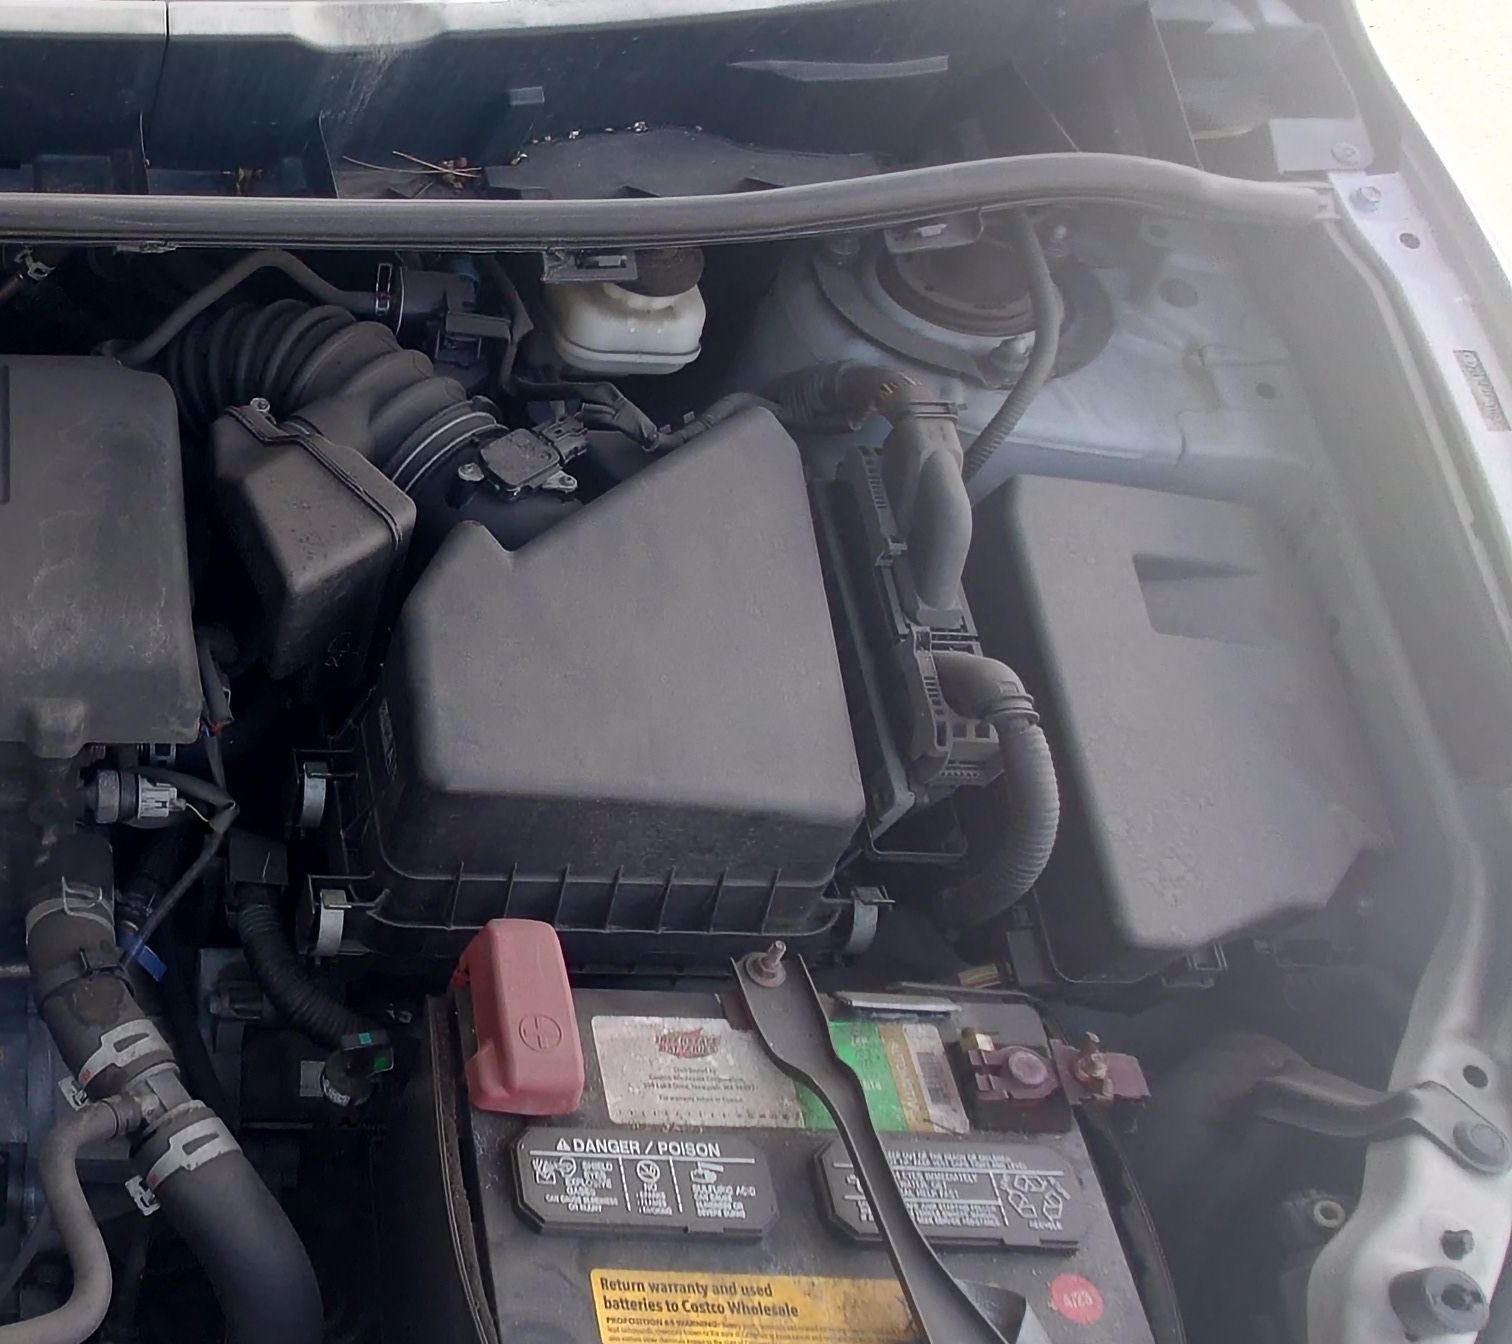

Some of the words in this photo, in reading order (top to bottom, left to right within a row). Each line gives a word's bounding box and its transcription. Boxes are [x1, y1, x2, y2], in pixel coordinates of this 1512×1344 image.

[573, 1138, 640, 1155] DANGER
[644, 1140, 653, 1154] /
[657, 1141, 721, 1157] POISON
[600, 1277, 645, 1292] Return
[648, 1281, 708, 1298] warranty
[712, 1281, 737, 1296] and
[741, 1283, 773, 1297] used
[603, 1296, 663, 1312] batteries
[665, 1299, 679, 1313] to
[682, 1300, 725, 1315] Costco
[727, 1301, 799, 1318] Wholesale
